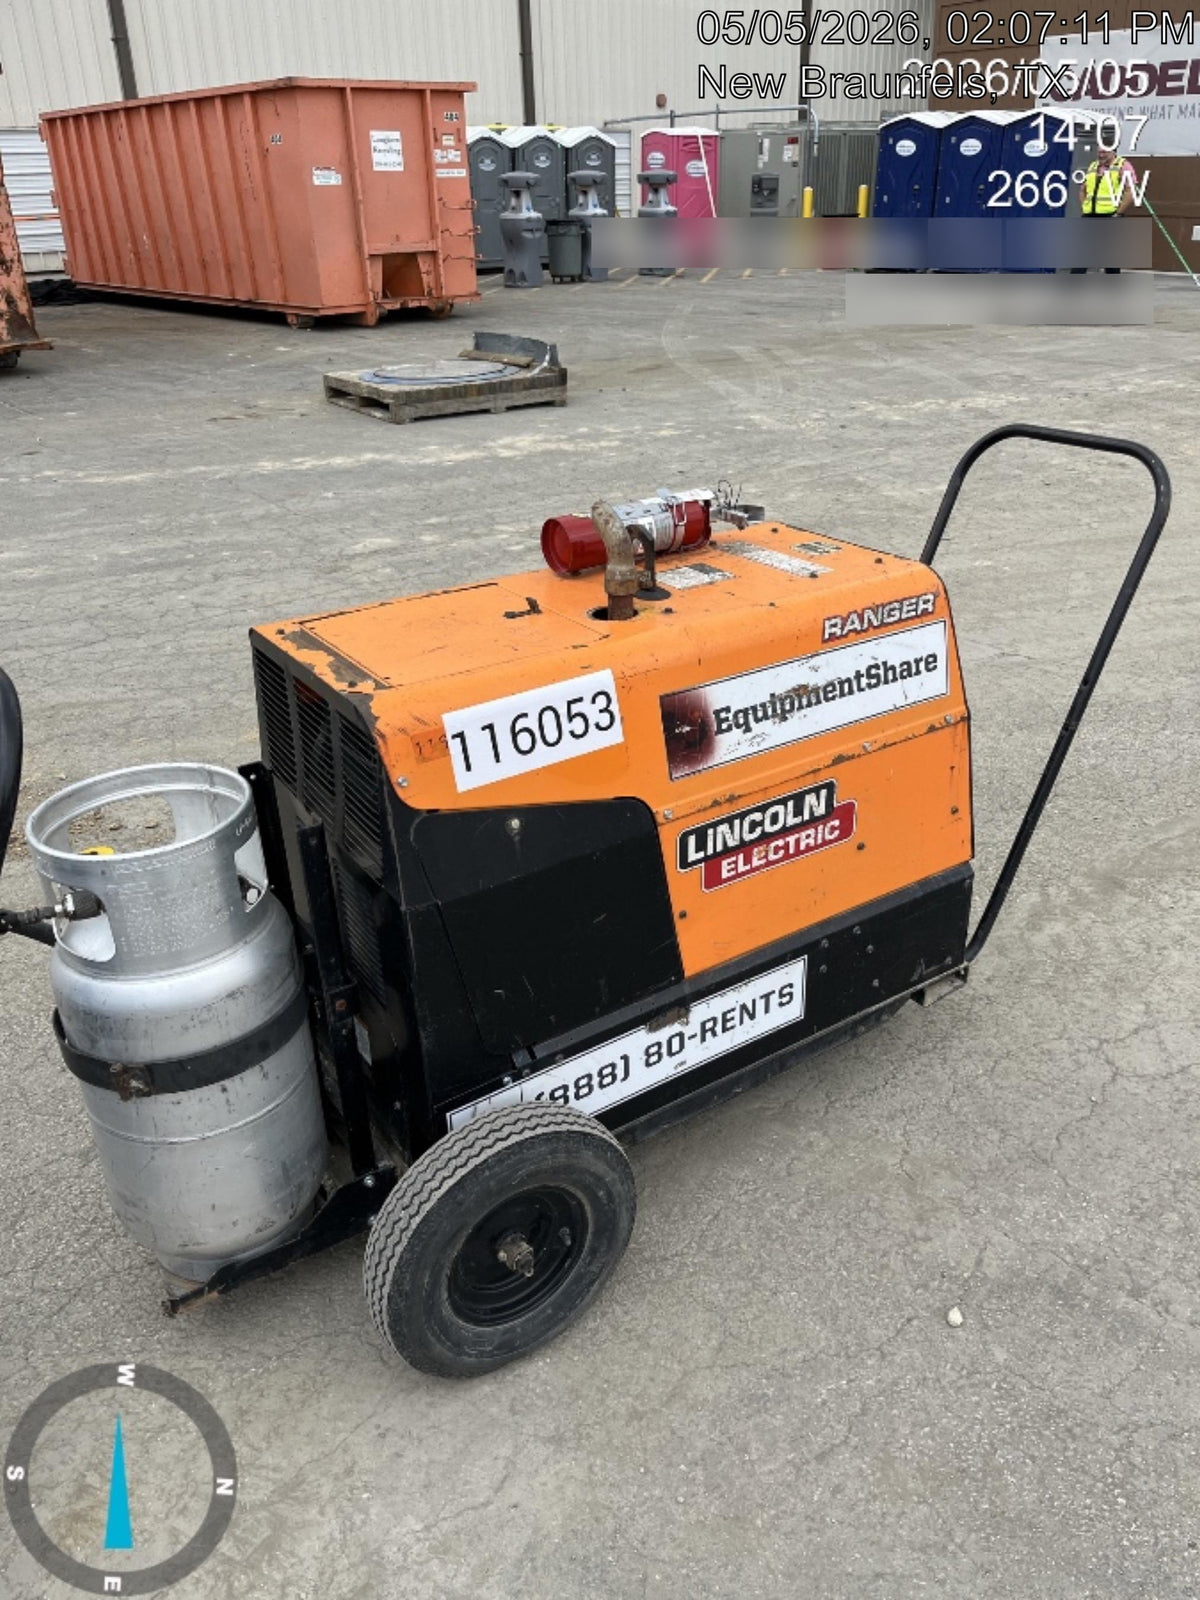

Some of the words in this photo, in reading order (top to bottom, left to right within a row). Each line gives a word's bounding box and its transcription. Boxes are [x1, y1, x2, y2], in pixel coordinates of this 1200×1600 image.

[822, 593, 937, 643] RANGER
[451, 690, 616, 772] 116053
[713, 652, 938, 736] EquipmentShare
[687, 789, 828, 863] LINCOLN
[720, 819, 840, 880] ELECTRIC
[535, 1053, 630, 1104] 888)
[644, 982, 795, 1067] 80-RENTS
